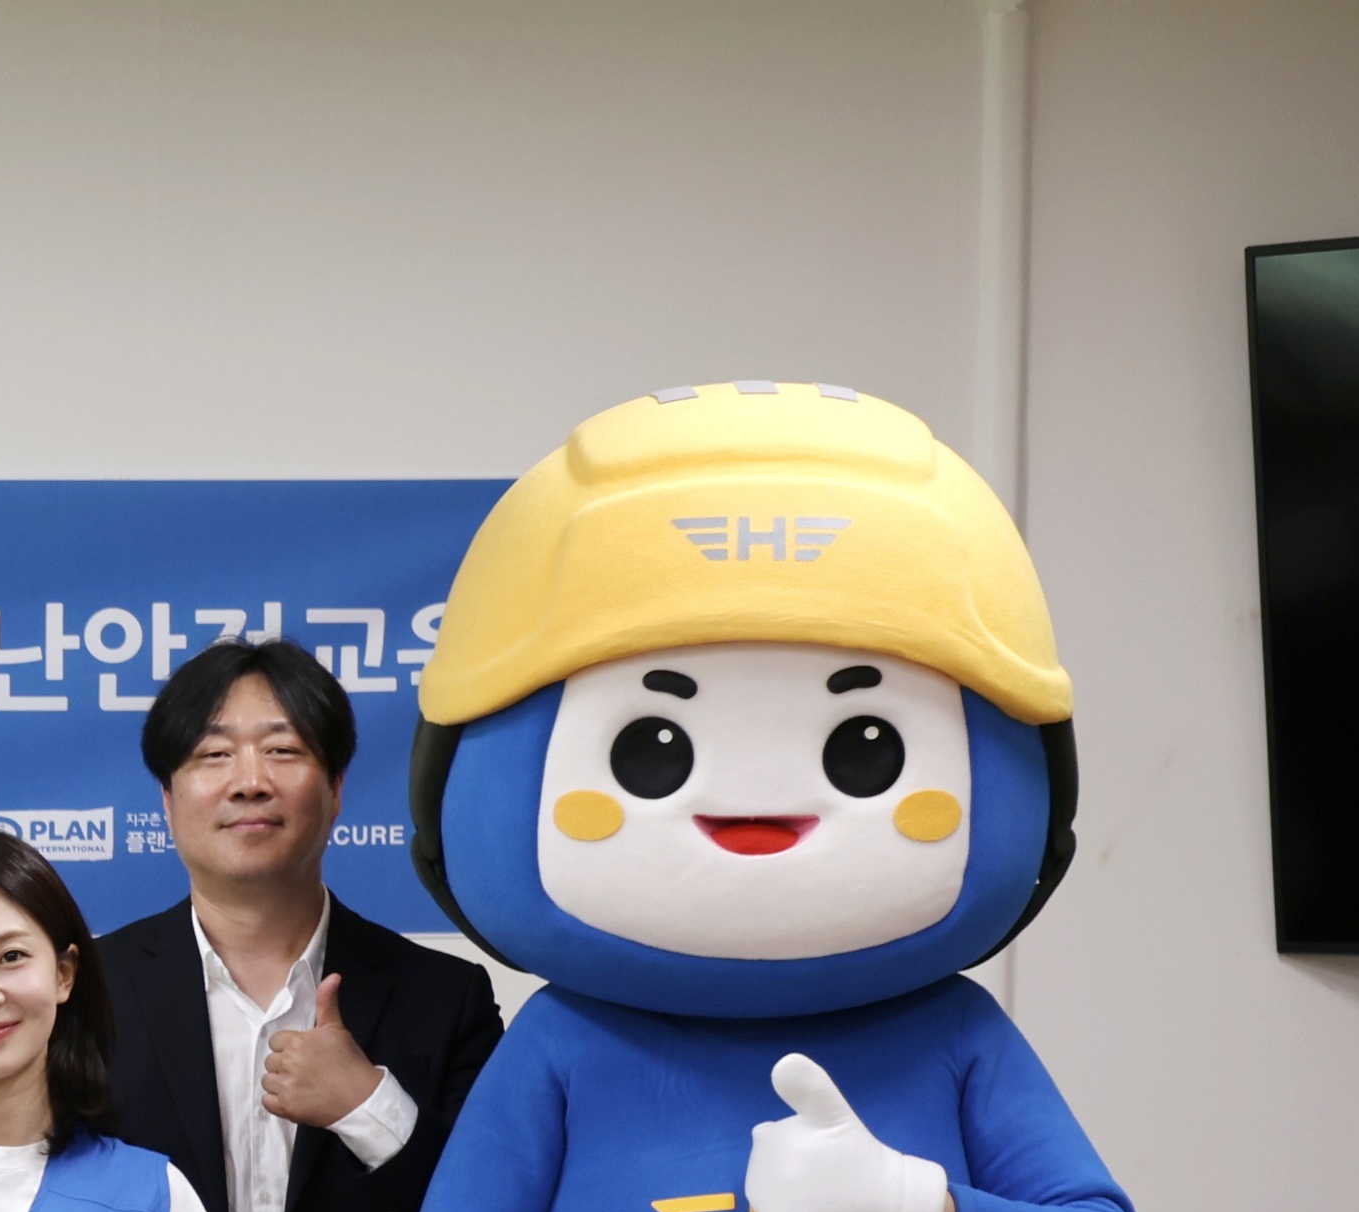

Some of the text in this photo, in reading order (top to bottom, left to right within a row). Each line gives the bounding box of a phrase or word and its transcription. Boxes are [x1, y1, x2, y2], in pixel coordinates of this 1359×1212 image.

[737, 516, 786, 561] H
[126, 812, 161, 827] 지구촌
[30, 821, 106, 840] PLAN
[33, 845, 106, 853] NTERNATIONAL
